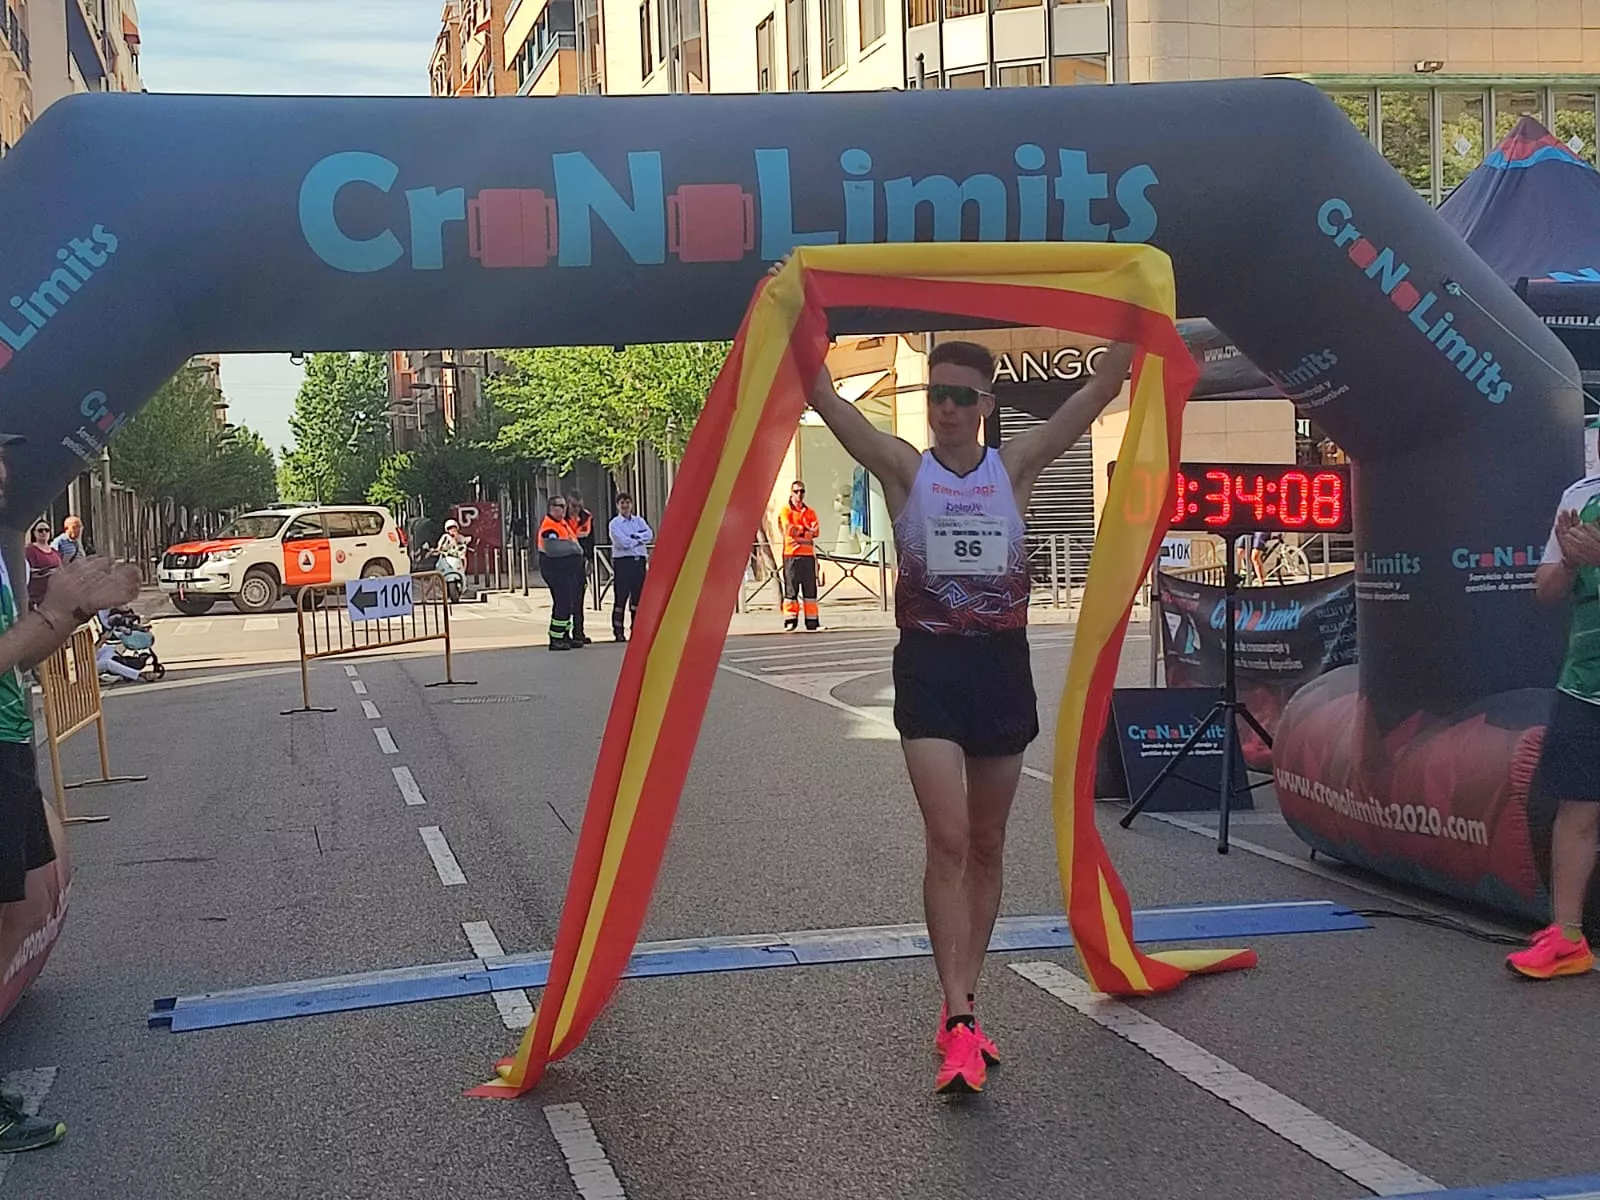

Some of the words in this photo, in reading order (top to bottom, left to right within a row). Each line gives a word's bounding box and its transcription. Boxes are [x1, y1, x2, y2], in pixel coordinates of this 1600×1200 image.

[0, 223, 119, 362] Limits
[954, 540, 982, 558] 86
[1170, 543, 1190, 560] 10K
[380, 582, 413, 608] 10K
[1277, 768, 1488, 846] www.cronolimits2020.com
